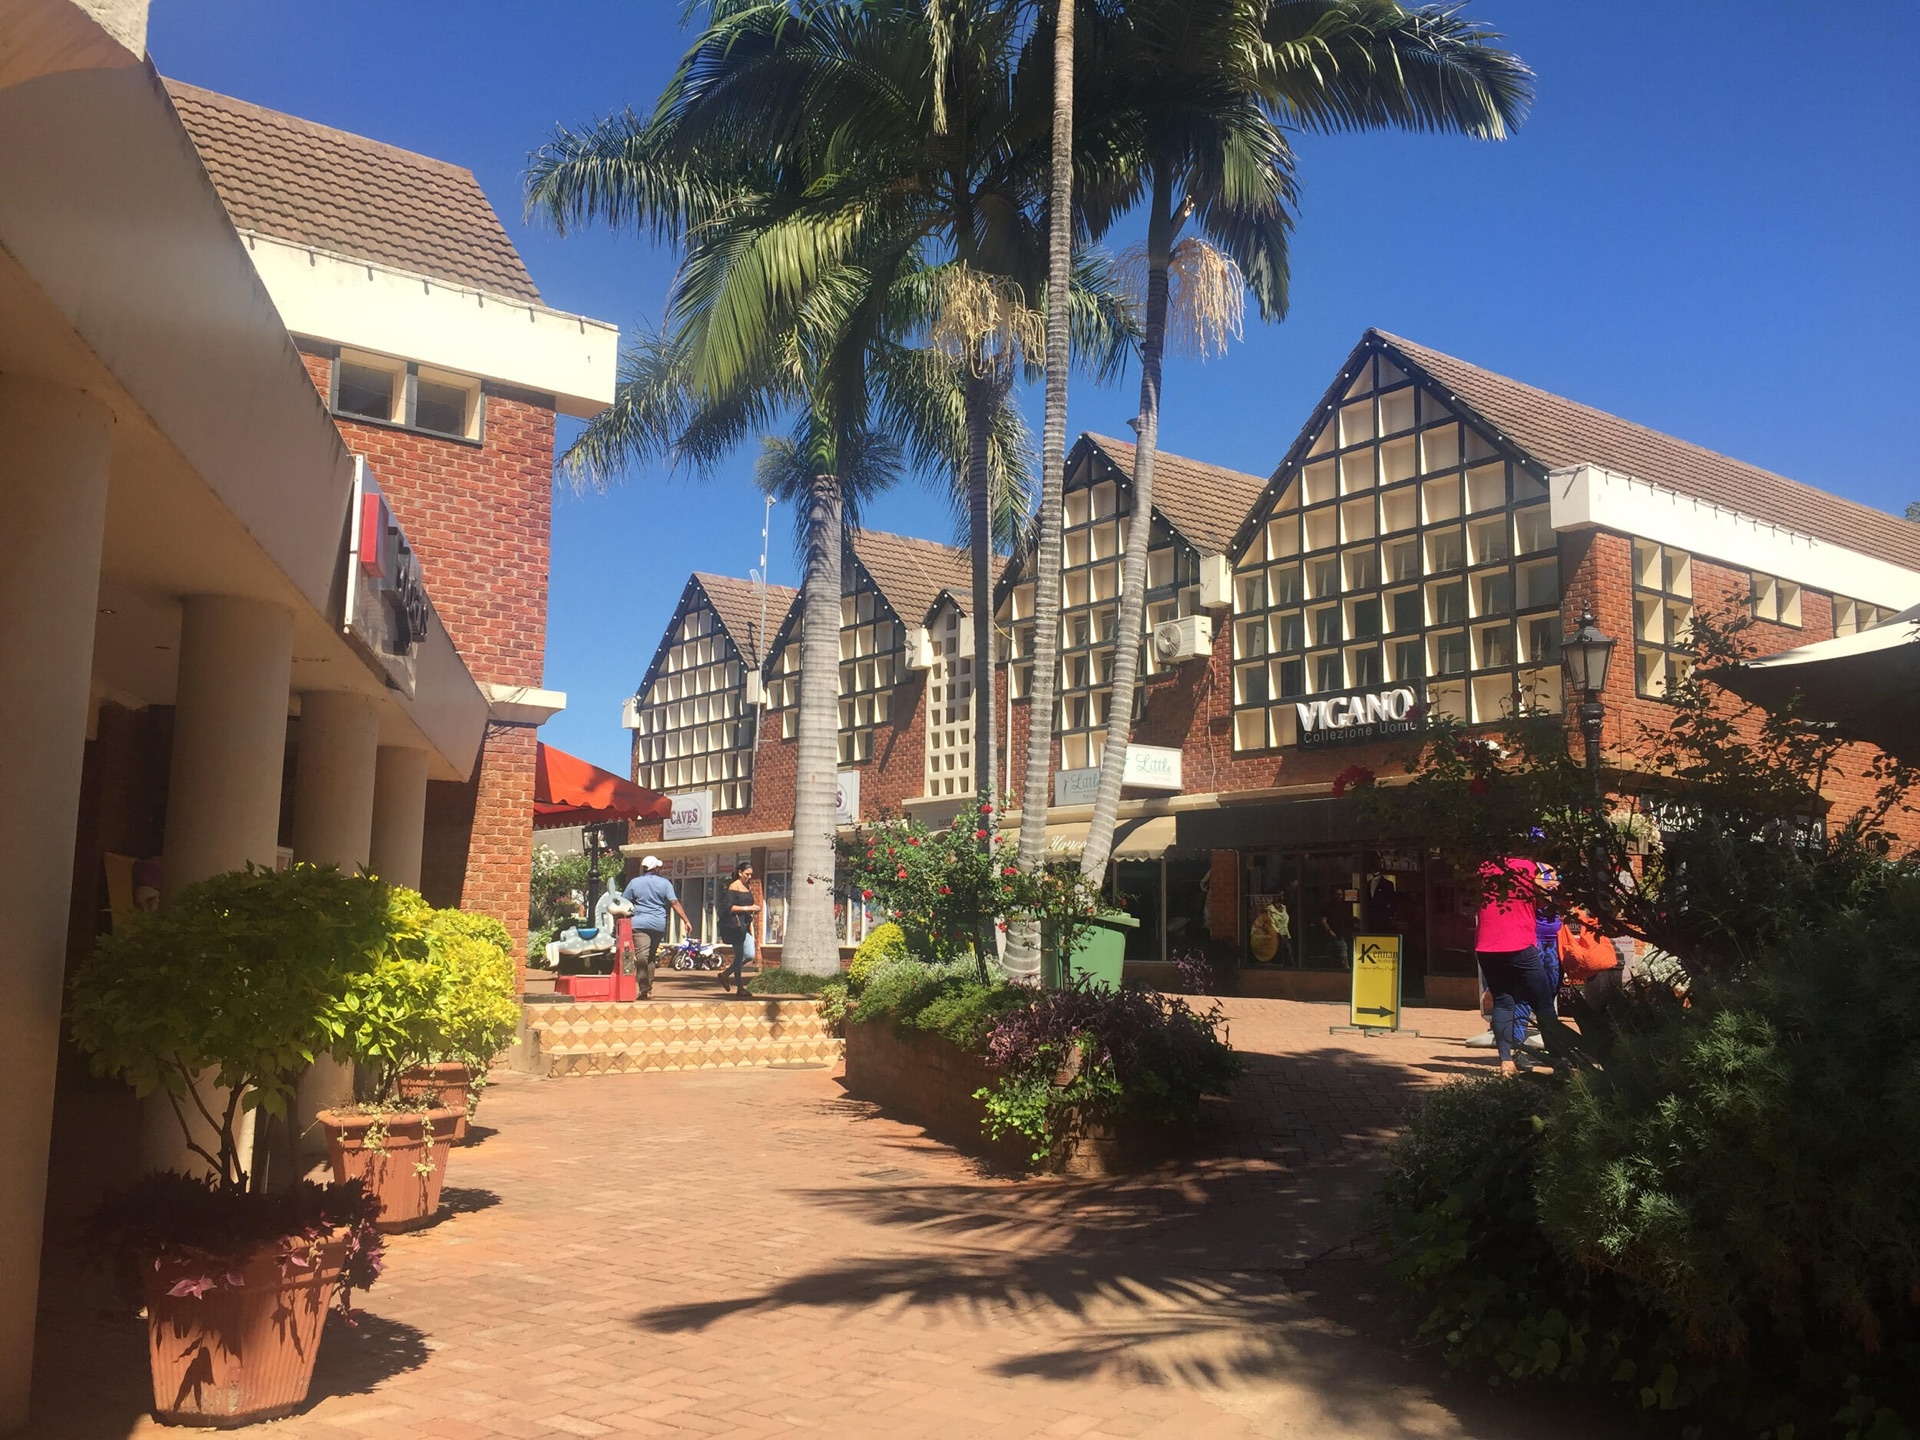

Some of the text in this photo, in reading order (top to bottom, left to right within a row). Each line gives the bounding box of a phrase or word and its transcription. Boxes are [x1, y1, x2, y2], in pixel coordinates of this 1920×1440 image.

[1303, 726, 1373, 744] Collezione
[1136, 753, 1172, 774] Little
[670, 808, 698, 825] CAVES
